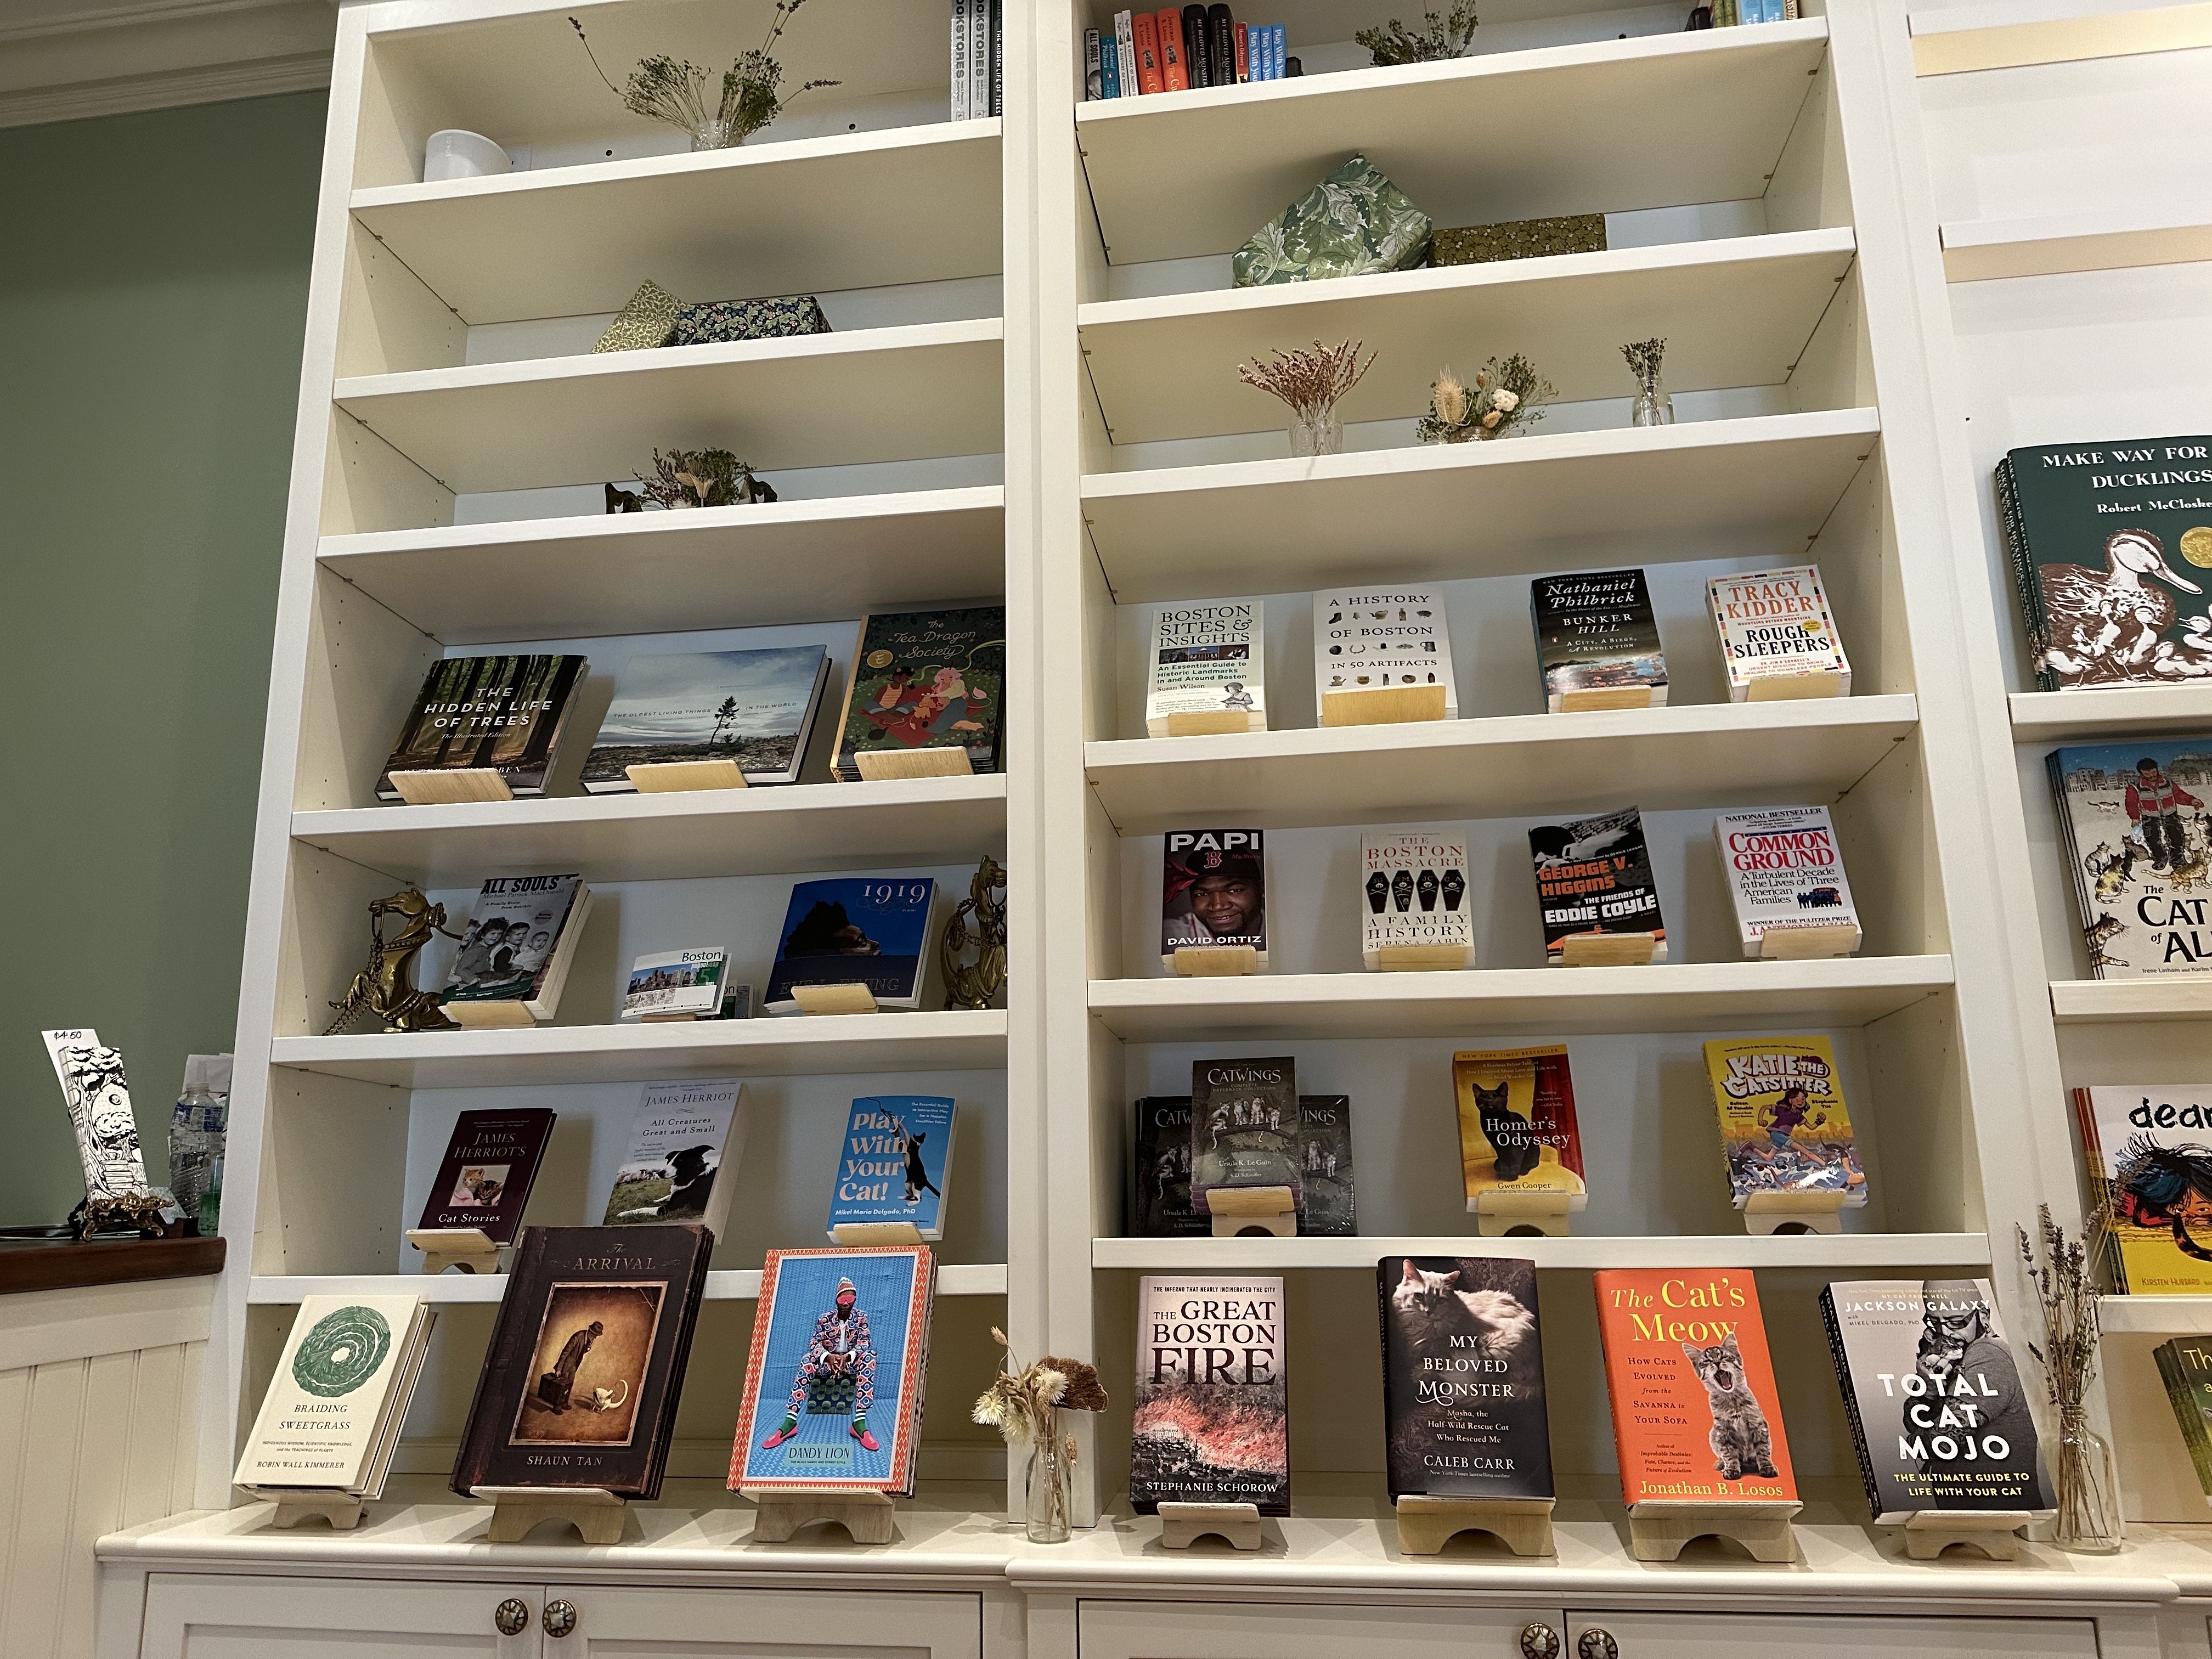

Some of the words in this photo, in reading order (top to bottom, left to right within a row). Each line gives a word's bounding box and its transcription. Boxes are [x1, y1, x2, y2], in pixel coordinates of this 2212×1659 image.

[956, 0, 964, 78] OOKSTORES
[1090, 45, 1098, 63] SOULS
[996, 84, 1001, 93] OF
[2042, 452, 2104, 467] MAKE
[2112, 449, 2155, 462] WAY
[2166, 446, 2207, 460] FOR
[2092, 470, 2212, 488] DUCKLINGS
[2097, 503, 2142, 514] Robert
[2149, 498, 2212, 511] McCloske
[1545, 579, 1635, 596] Nathaniel
[1728, 581, 1801, 602] TRACY
[1349, 595, 1429, 605] HISTORY
[1550, 592, 1634, 608] Philbrick
[1161, 605, 1251, 623] BOSTON
[1726, 597, 1814, 619] KIDDER
[928, 620, 944, 629] The
[1564, 613, 1633, 626] BUNKER
[1161, 620, 1226, 636] SITES
[1233, 619, 1252, 630] &
[1330, 630, 1352, 639] OF
[1361, 627, 1433, 636] BOSTON
[1578, 624, 1620, 634] HILL
[1746, 625, 1810, 642] ROUGH
[894, 633, 916, 644] Tea
[919, 631, 975, 644] Dragon
[1159, 633, 1249, 647] INSIGHTS
[899, 645, 964, 659] Society
[1734, 637, 1830, 658] SLEEPERS
[477, 688, 513, 697] THE
[424, 702, 501, 713] HIDDEN
[509, 701, 552, 711] LIFE
[434, 718, 461, 727] OF
[471, 715, 529, 726] TREES
[1725, 813, 1767, 822] NATIONAL
[1769, 808, 1821, 818] BESTSELLER
[1171, 833, 1259, 852] PAPI
[1729, 831, 1830, 853] COMMON
[1367, 846, 1463, 860] BOSTON
[1734, 848, 1835, 871] GROUND
[1368, 858, 1463, 870] MASSACRE
[1539, 861, 1609, 881] GEORGE
[1613, 856, 1633, 870] V.
[481, 878, 506, 894] ALL
[511, 877, 560, 893] SOULS
[1541, 876, 1615, 896] HIGGINS
[1745, 888, 1792, 897] American
[2143, 885, 2164, 894] The
[862, 885, 926, 904] 1919
[1601, 890, 1633, 902] FRIENDS
[1635, 888, 1645, 896] OF
[1751, 896, 1791, 905] Families
[1545, 906, 1598, 923] EDDIE
[1601, 894, 1656, 918] COYLE
[1368, 918, 1377, 927] A
[1389, 915, 1467, 925] FAMILY
[1168, 936, 1214, 945] DAVID
[1368, 926, 1469, 940] HISTORY
[2151, 933, 2162, 944] of
[682, 951, 721, 962] Boston
[54, 1031, 82, 1041] $4.50
[1728, 1054, 1800, 1079] KATIE
[1801, 1062, 1825, 1074] THE
[1207, 1067, 1281, 1085] CATWINGS
[1720, 1075, 1830, 1097] CATSITTER
[645, 1096, 679, 1107] JAMES
[682, 1092, 734, 1103] HERRIOT
[853, 1113, 906, 1133] Play
[1486, 1116, 1556, 1131] Homer's
[473, 1132, 516, 1146] JAMES
[851, 1136, 907, 1155] With
[1497, 1133, 1571, 1150] Odyssey
[454, 1147, 527, 1158] HERRIOT'S
[843, 1159, 905, 1181] your
[839, 1182, 889, 1201] Cat!
[1522, 1182, 1551, 1190] Cooper
[439, 1214, 457, 1222] Cat
[461, 1214, 500, 1222] Stories
[607, 1243, 627, 1254] The
[572, 1257, 656, 1271] ARRIVAL
[1610, 1289, 1654, 1308] The
[1661, 1278, 1745, 1308] Cat's
[1153, 1312, 1176, 1320] THE
[1181, 1301, 1276, 1320] GREAT
[1846, 1301, 1919, 1312] JACKSON
[1927, 1300, 1990, 1311] GALAXY
[1152, 1324, 1277, 1344] BOSTON
[1628, 1313, 1738, 1342] Meow
[1450, 1335, 1478, 1348] MY
[1150, 1347, 1277, 1385] FIRE
[1423, 1358, 1508, 1373] BELOVED
[1877, 1373, 1999, 1397] TOTAL
[1415, 1380, 1514, 1406] MONSTER
[1910, 1403, 1978, 1429] CAT
[279, 1421, 351, 1430] SWEETGRASS
[788, 1447, 822, 1459] DANDY
[825, 1447, 850, 1459] LION
[1899, 1435, 2010, 1460] MOJO
[527, 1455, 571, 1465] SHAUN
[577, 1457, 603, 1466] TAN
[1424, 1455, 1469, 1468] CALEB
[1474, 1457, 1515, 1470] CARR
[1894, 1474, 1916, 1482] THE
[1919, 1473, 1972, 1482] ULTIMATE
[1976, 1473, 2011, 1481] GUIDE
[2014, 1472, 2030, 1481] TO
[1147, 1482, 1213, 1491] STEPHANIE
[1217, 1483, 1278, 1492] SCHOROW
[1640, 1481, 1712, 1495] Jonathan
[1718, 1482, 1733, 1496] B.
[1739, 1482, 1783, 1497] Losos
